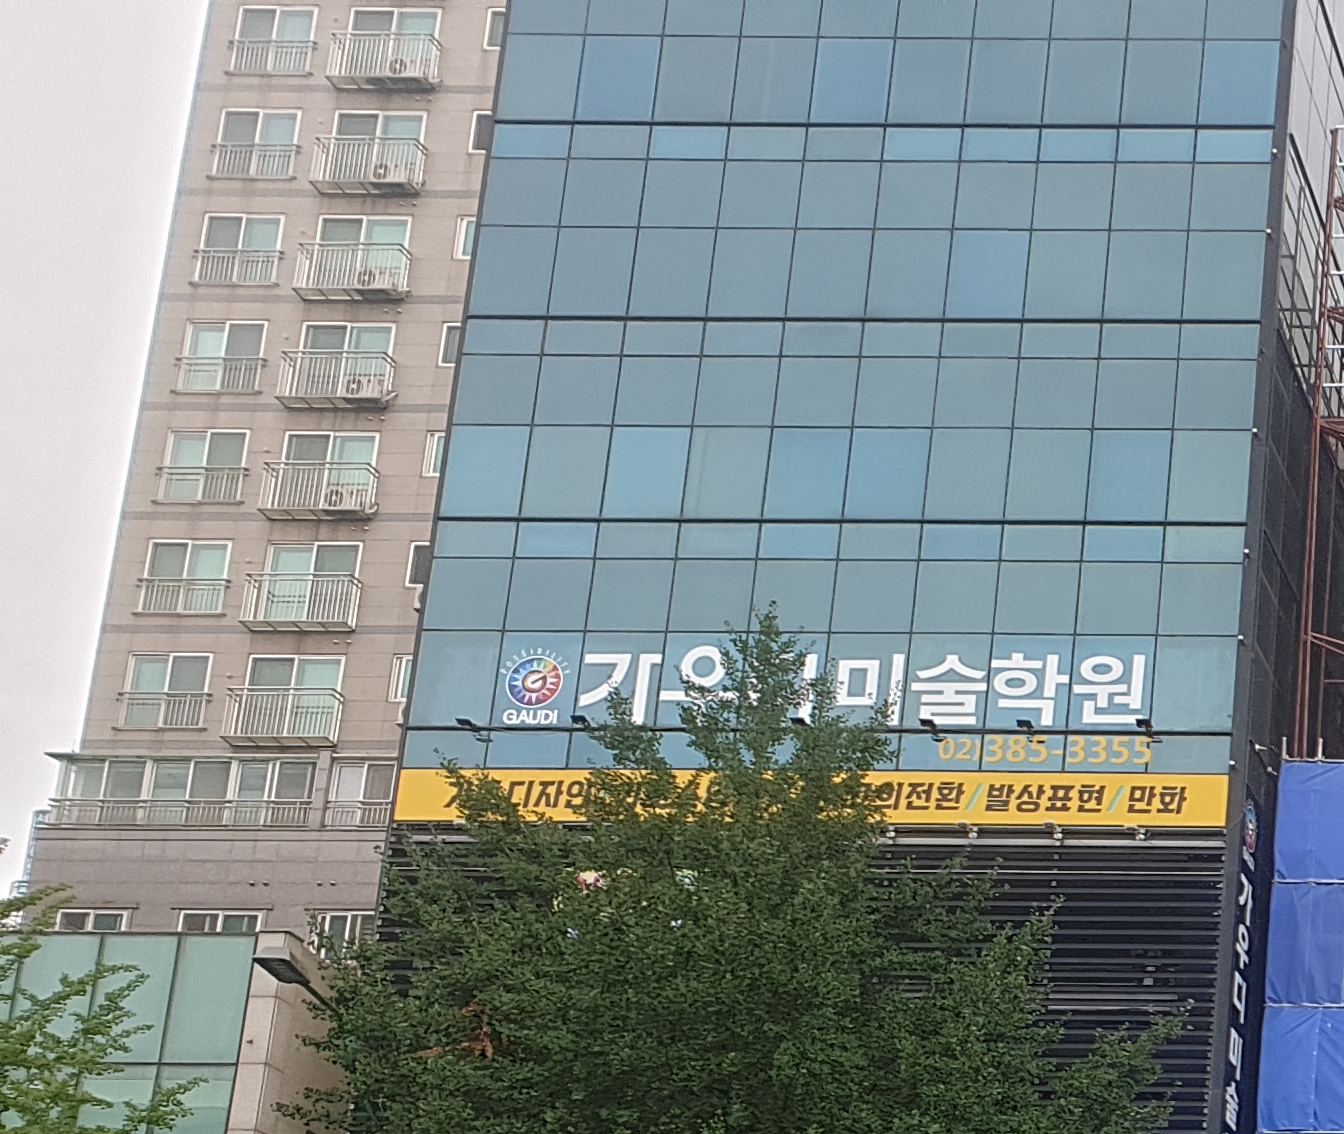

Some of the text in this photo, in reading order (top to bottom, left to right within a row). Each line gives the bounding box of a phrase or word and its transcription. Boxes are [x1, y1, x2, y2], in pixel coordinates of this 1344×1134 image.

[578, 645, 1147, 726] 가우미술학원
[502, 709, 558, 725] GAUDI
[984, 783, 1107, 814] 발상표현
[1126, 785, 1188, 815] 만화
